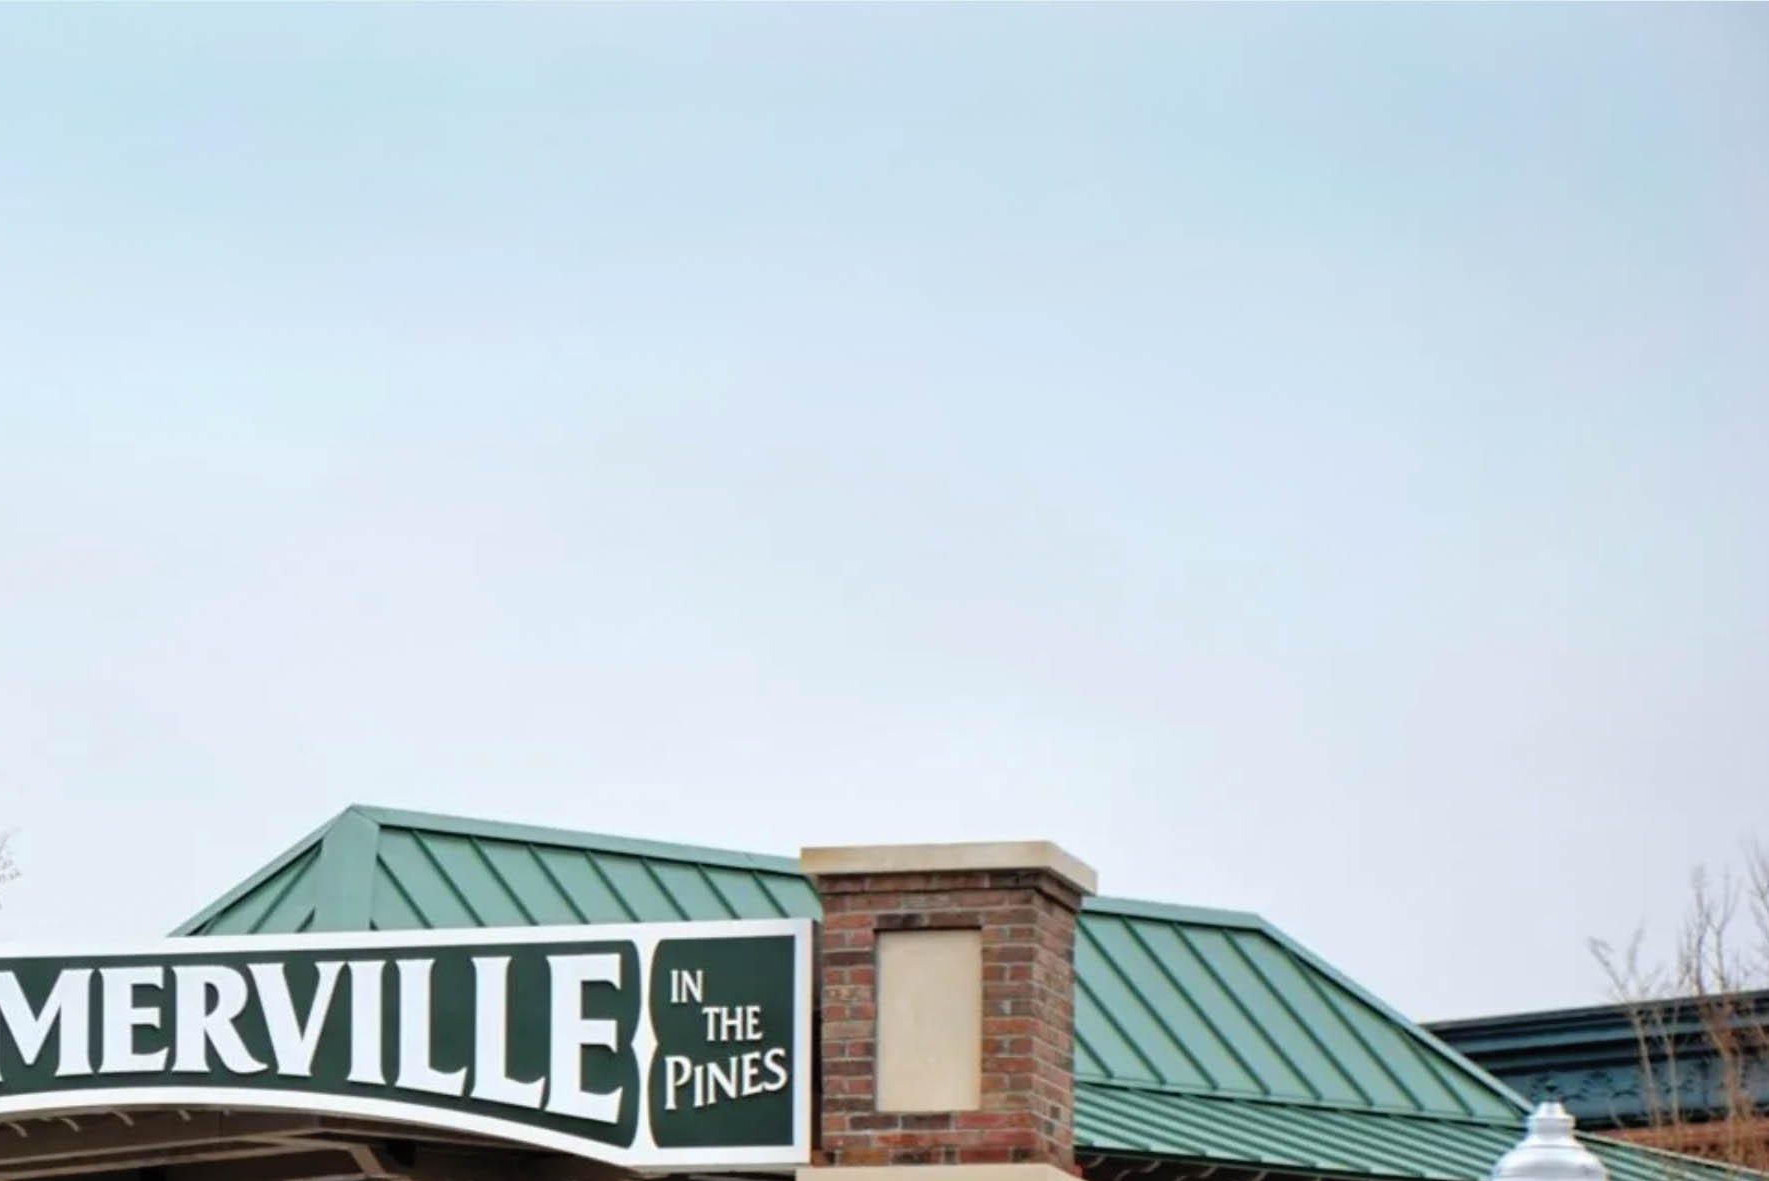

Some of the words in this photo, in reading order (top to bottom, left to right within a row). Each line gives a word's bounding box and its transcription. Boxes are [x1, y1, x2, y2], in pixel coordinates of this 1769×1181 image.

[670, 969, 703, 1003] IN
[701, 1005, 764, 1041] THE
[664, 1047, 788, 1110] PINES
